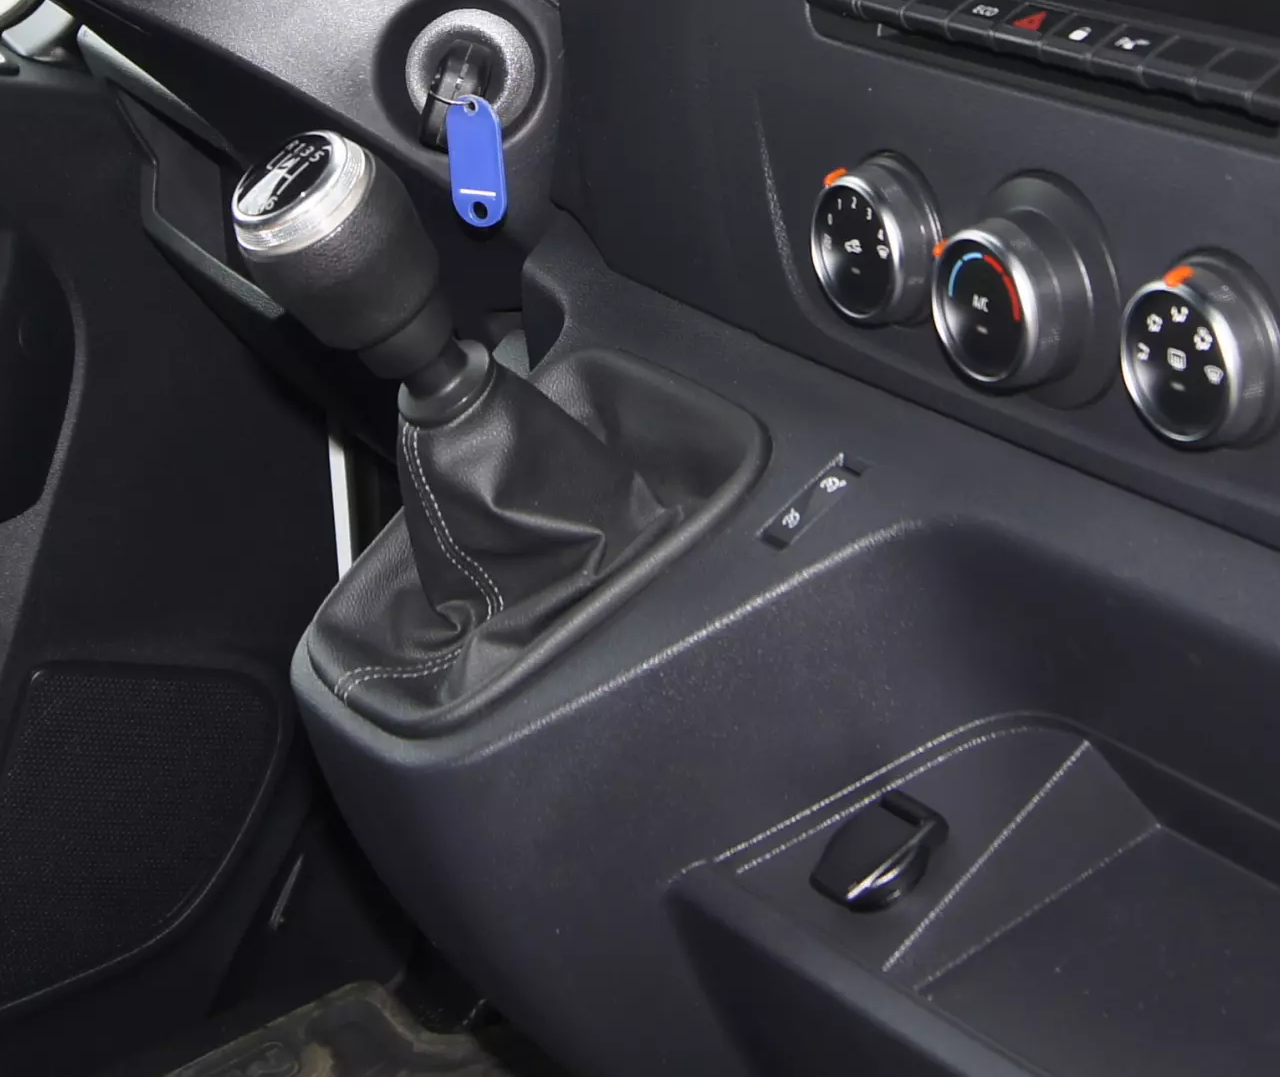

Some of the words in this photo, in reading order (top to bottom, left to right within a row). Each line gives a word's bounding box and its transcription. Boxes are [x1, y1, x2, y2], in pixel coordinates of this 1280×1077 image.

[971, 4, 1000, 17] ECO
[300, 145, 314, 157] 3
[309, 151, 325, 162] 5
[851, 195, 857, 210] 2
[866, 206, 872, 221] 3
